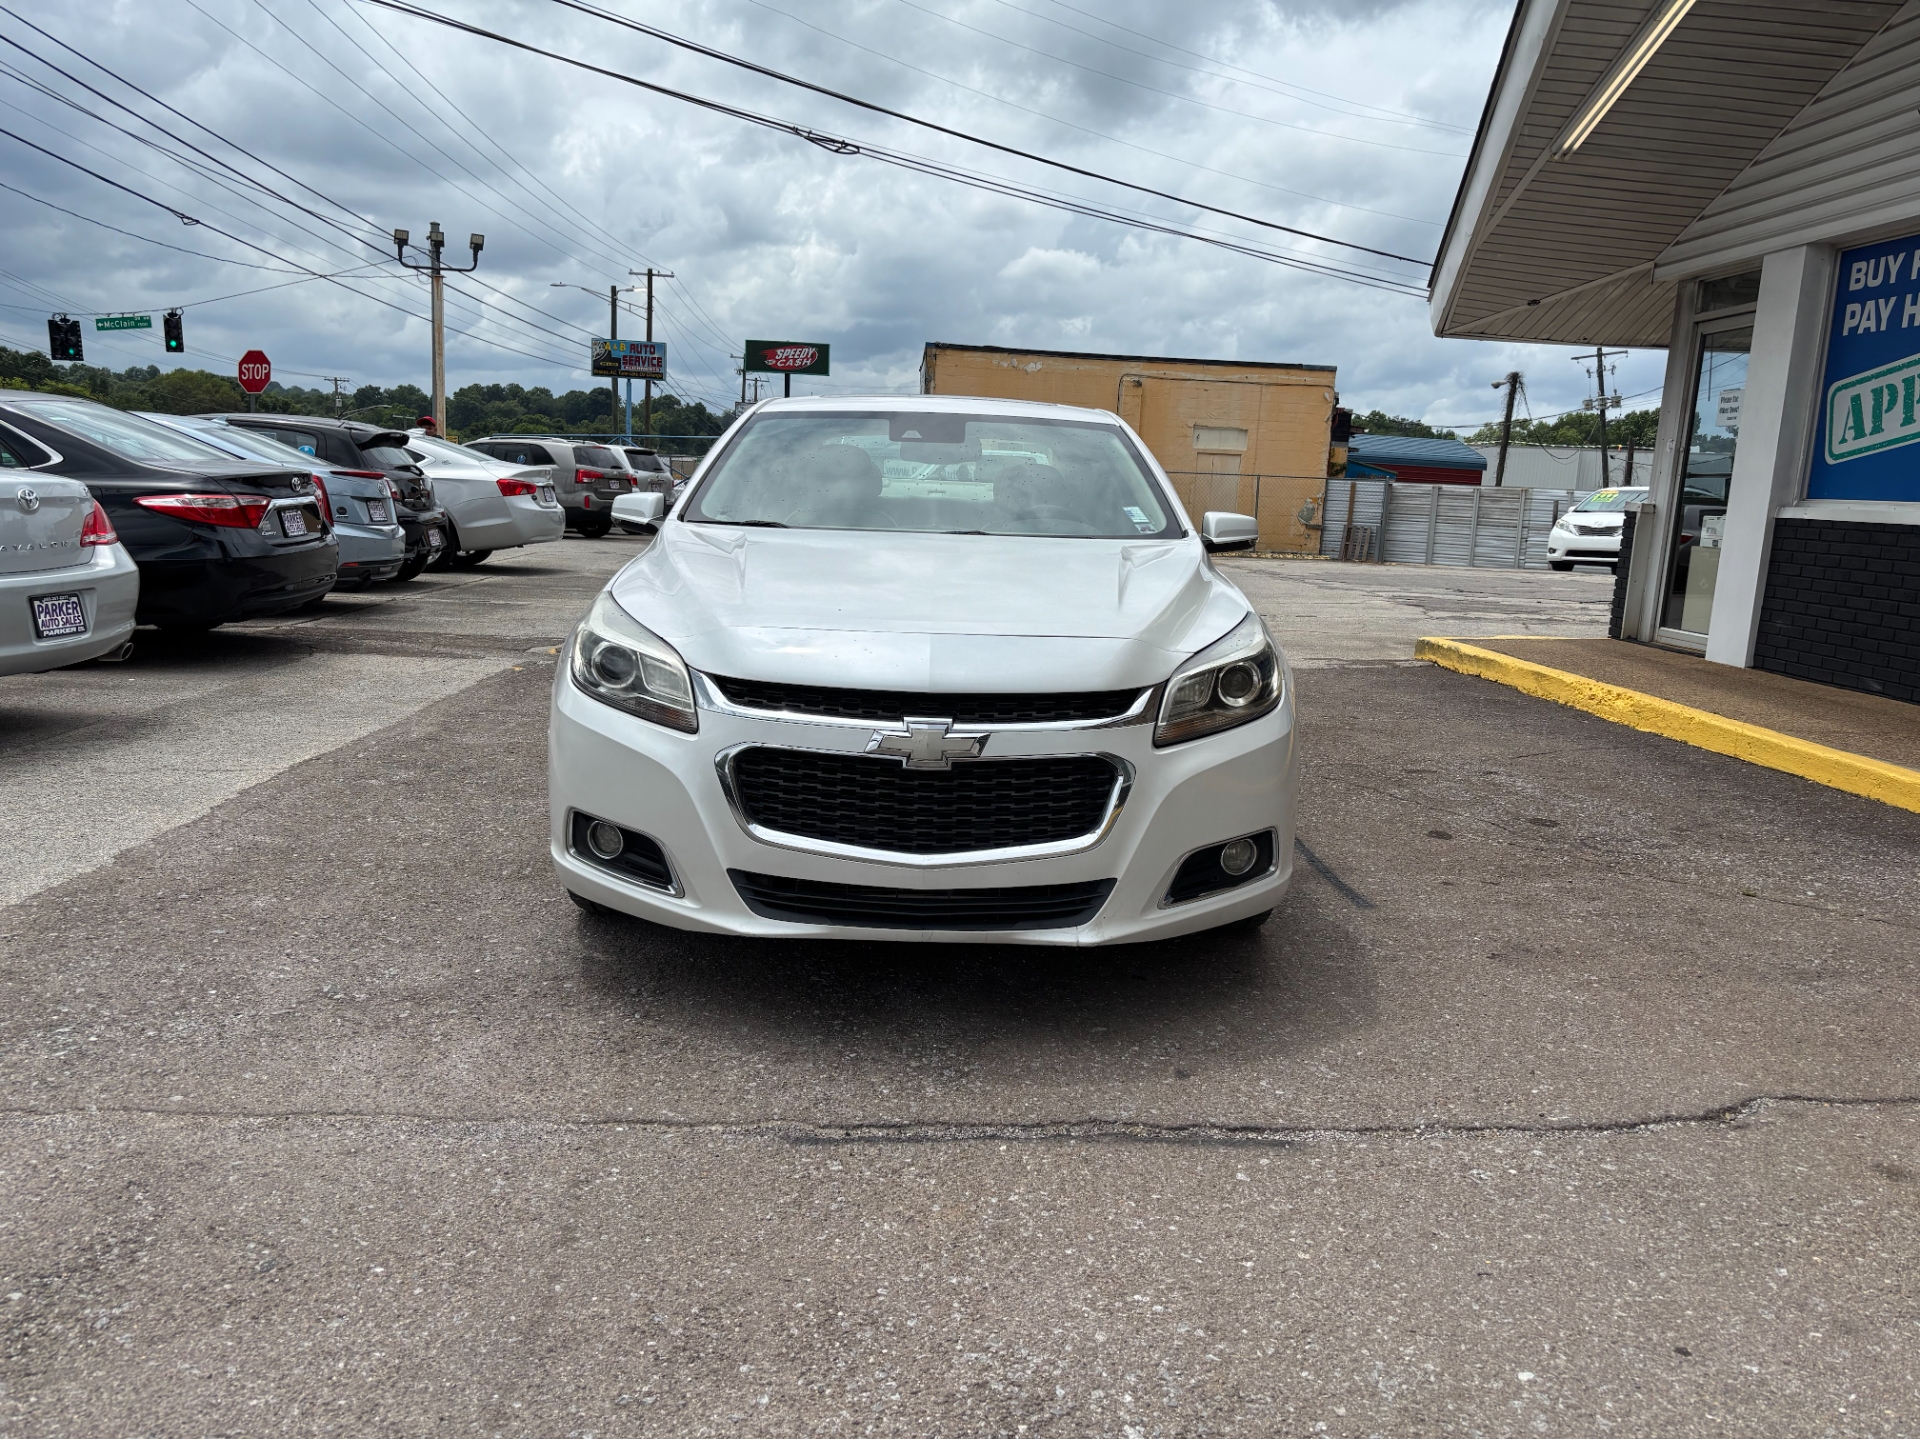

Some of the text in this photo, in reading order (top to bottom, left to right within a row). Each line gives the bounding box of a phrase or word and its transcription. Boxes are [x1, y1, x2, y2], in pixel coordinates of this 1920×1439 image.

[1849, 252, 1907, 291] BUY
[1842, 292, 1920, 337] PAY H
[104, 319, 135, 328] McClain
[619, 343, 626, 352] B
[629, 343, 656, 355] AUTO
[775, 347, 816, 360] SPEEDY
[621, 354, 663, 368] SERVICE
[241, 363, 270, 380] STOP
[0, 540, 68, 552] AVALON
[36, 600, 80, 620] PARKER
[41, 614, 82, 629] AUTO SALES
[43, 627, 77, 637] PARKER
